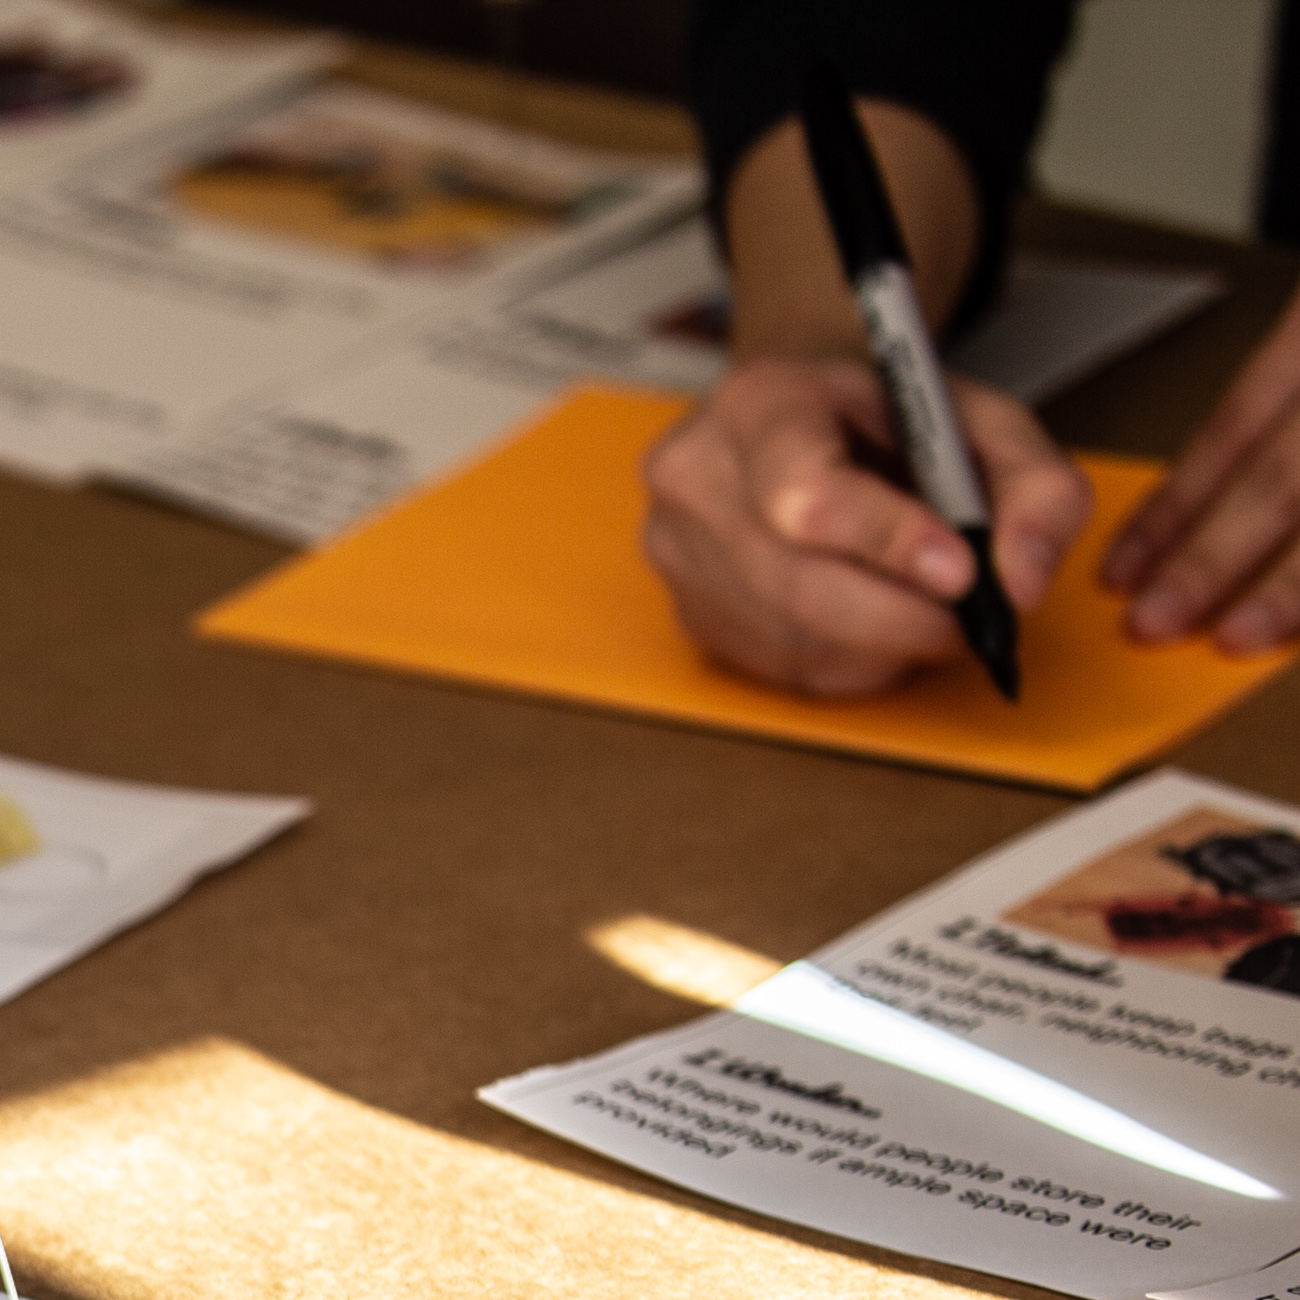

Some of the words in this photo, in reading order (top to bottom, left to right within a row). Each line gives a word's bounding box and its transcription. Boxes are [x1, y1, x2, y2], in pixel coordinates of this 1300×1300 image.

[610, 1078, 803, 1156] belongings
[838, 1157, 952, 1197] ample
[957, 1188, 1072, 1226] space
[1079, 1219, 1172, 1251] were
[647, 1065, 761, 1116] Where
[768, 1109, 881, 1151] would
[875, 1140, 1005, 1184] people
[1010, 1175, 1106, 1210] store
[1113, 1200, 1203, 1233] their
